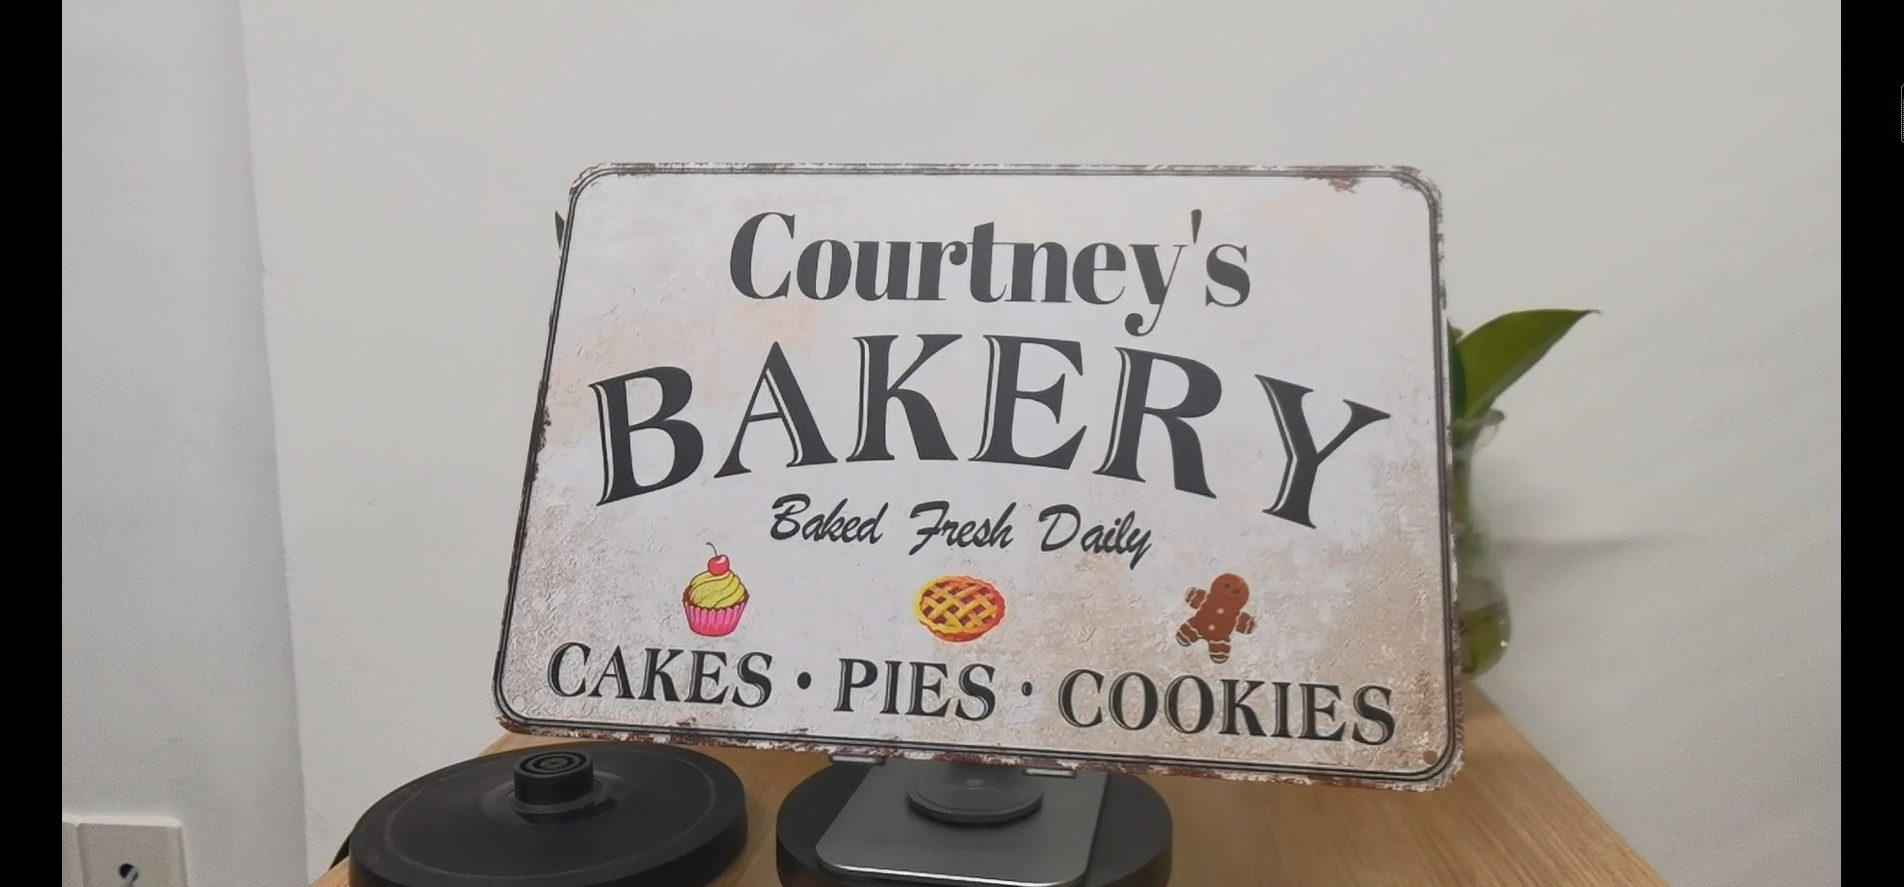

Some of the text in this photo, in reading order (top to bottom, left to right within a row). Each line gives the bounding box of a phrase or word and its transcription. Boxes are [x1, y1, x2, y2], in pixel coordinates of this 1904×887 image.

[729, 209, 1252, 337] Courtney's
[589, 334, 1391, 529] BAKERY
[770, 493, 1153, 570] Baked Fresh Daily
[547, 641, 1397, 746] CAKES PIES COOKIES
